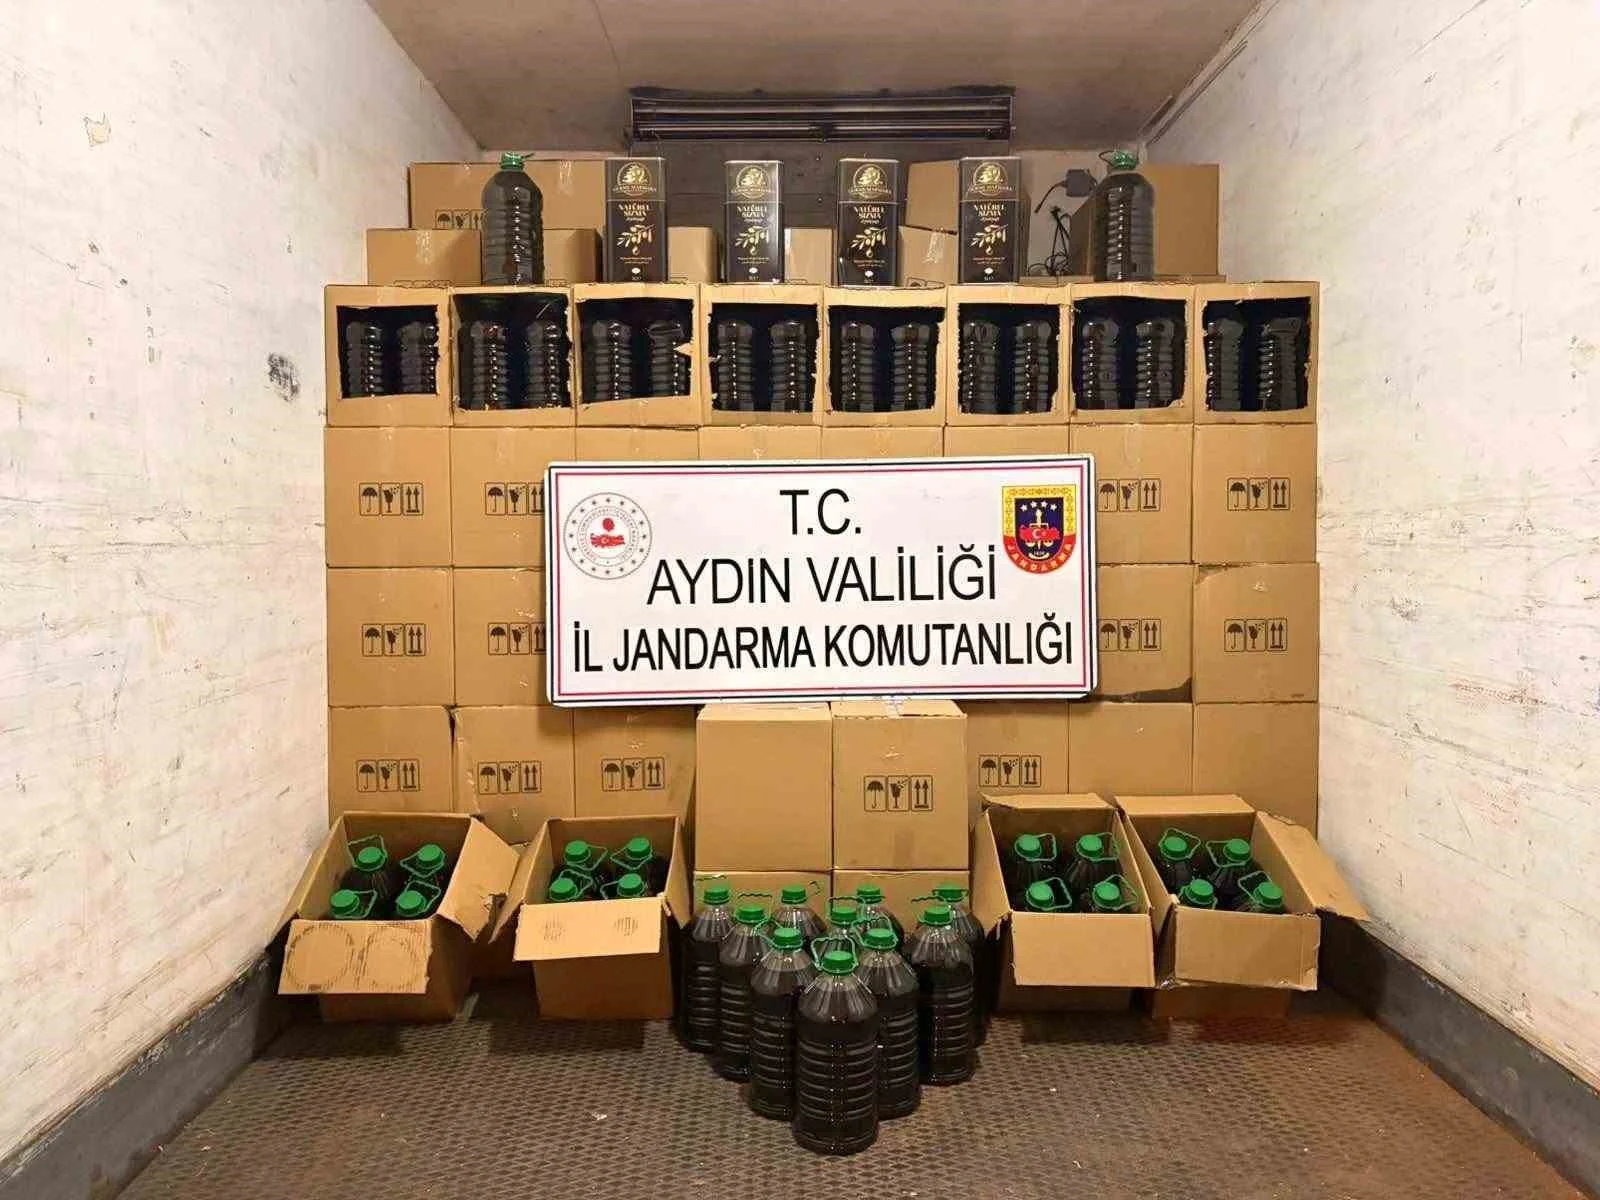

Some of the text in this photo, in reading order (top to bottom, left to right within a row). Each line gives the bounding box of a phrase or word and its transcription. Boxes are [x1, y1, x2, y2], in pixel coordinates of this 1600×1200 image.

[780, 489, 861, 535] T.C.
[647, 543, 996, 605] AYDIN VALİLİĞİ
[575, 613, 1072, 673] İL JANDARMA KOMUTANLIĞI
